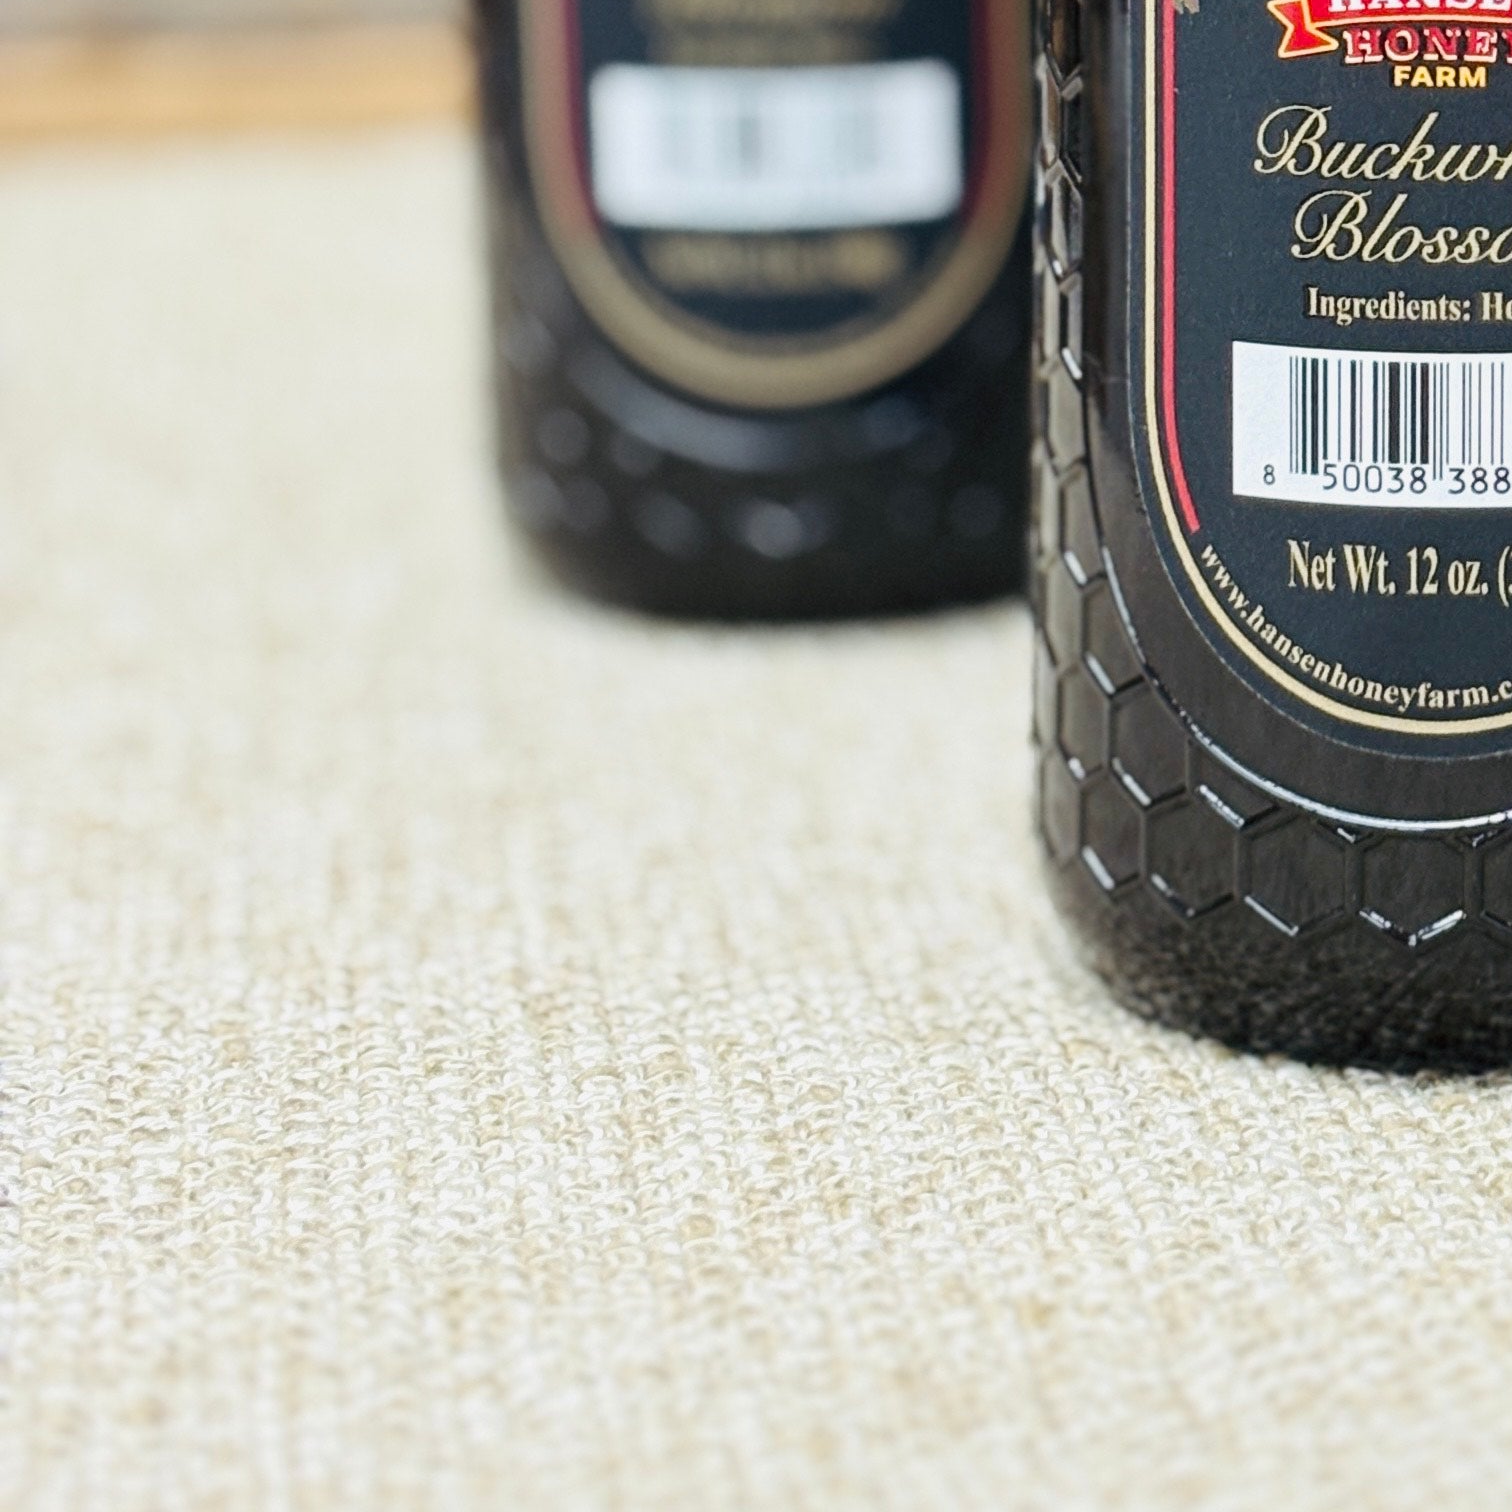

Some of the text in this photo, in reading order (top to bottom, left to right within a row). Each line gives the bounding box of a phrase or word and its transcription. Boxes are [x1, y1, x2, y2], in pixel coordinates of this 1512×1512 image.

[1393, 66, 1487, 88] FARM
[1307, 287, 1472, 325] Ingredients:
[1262, 465, 1276, 487] 8
[1323, 466, 1428, 494] 50038
[1287, 539, 1337, 591] Net
[1343, 543, 1397, 595] Wt.
[1405, 546, 1442, 596] 12
[1447, 557, 1489, 596] oz.
